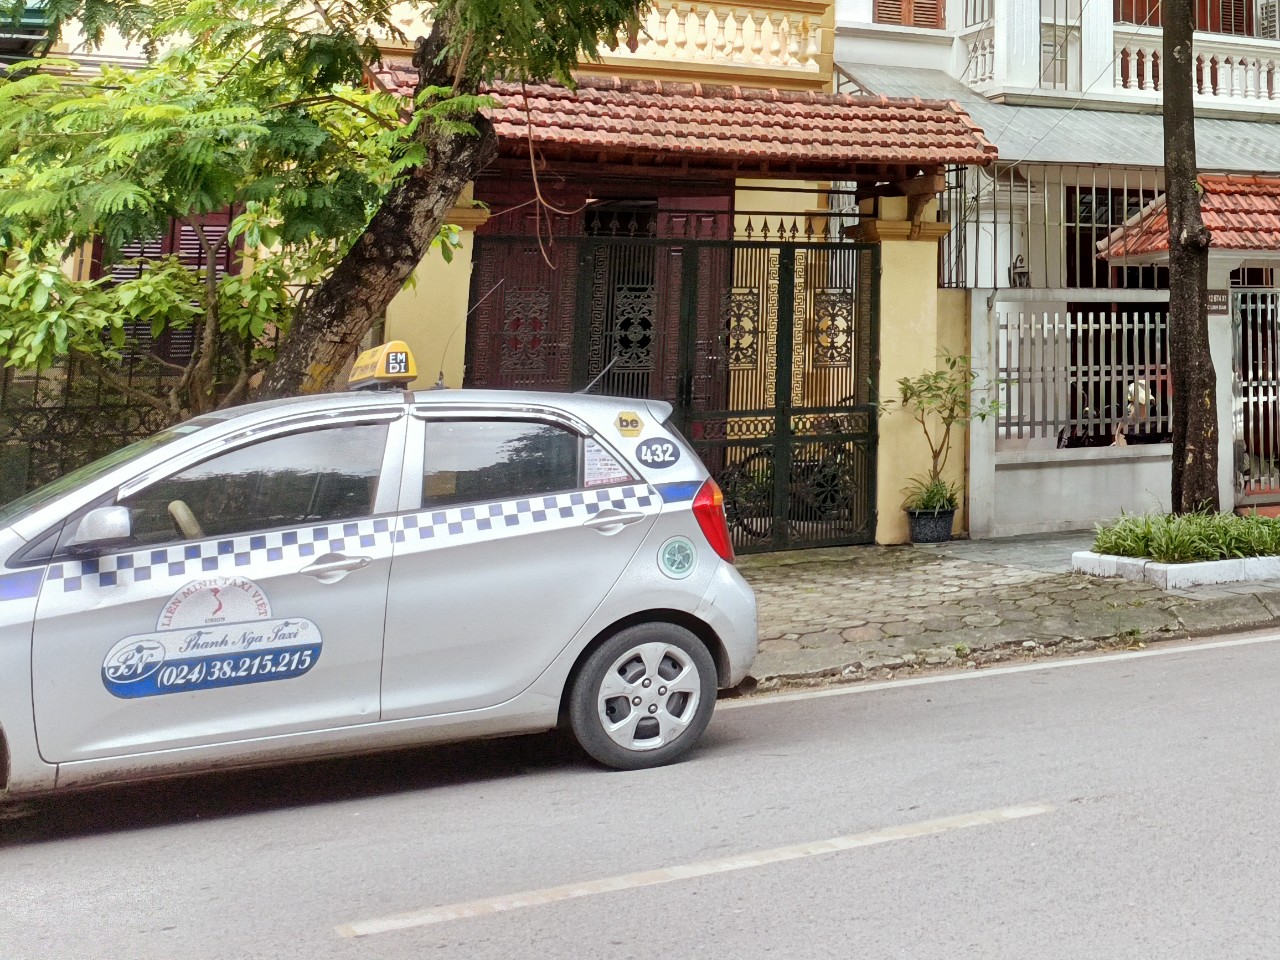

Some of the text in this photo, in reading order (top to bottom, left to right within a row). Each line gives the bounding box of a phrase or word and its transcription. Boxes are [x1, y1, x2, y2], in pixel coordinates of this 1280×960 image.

[389, 353, 406, 363] EM
[389, 363, 406, 373] DI
[619, 417, 639, 428] be
[642, 443, 675, 462] 432
[182, 579, 218, 598] MINH
[223, 577, 252, 592] TAXI
[231, 631, 264, 649] Nga
